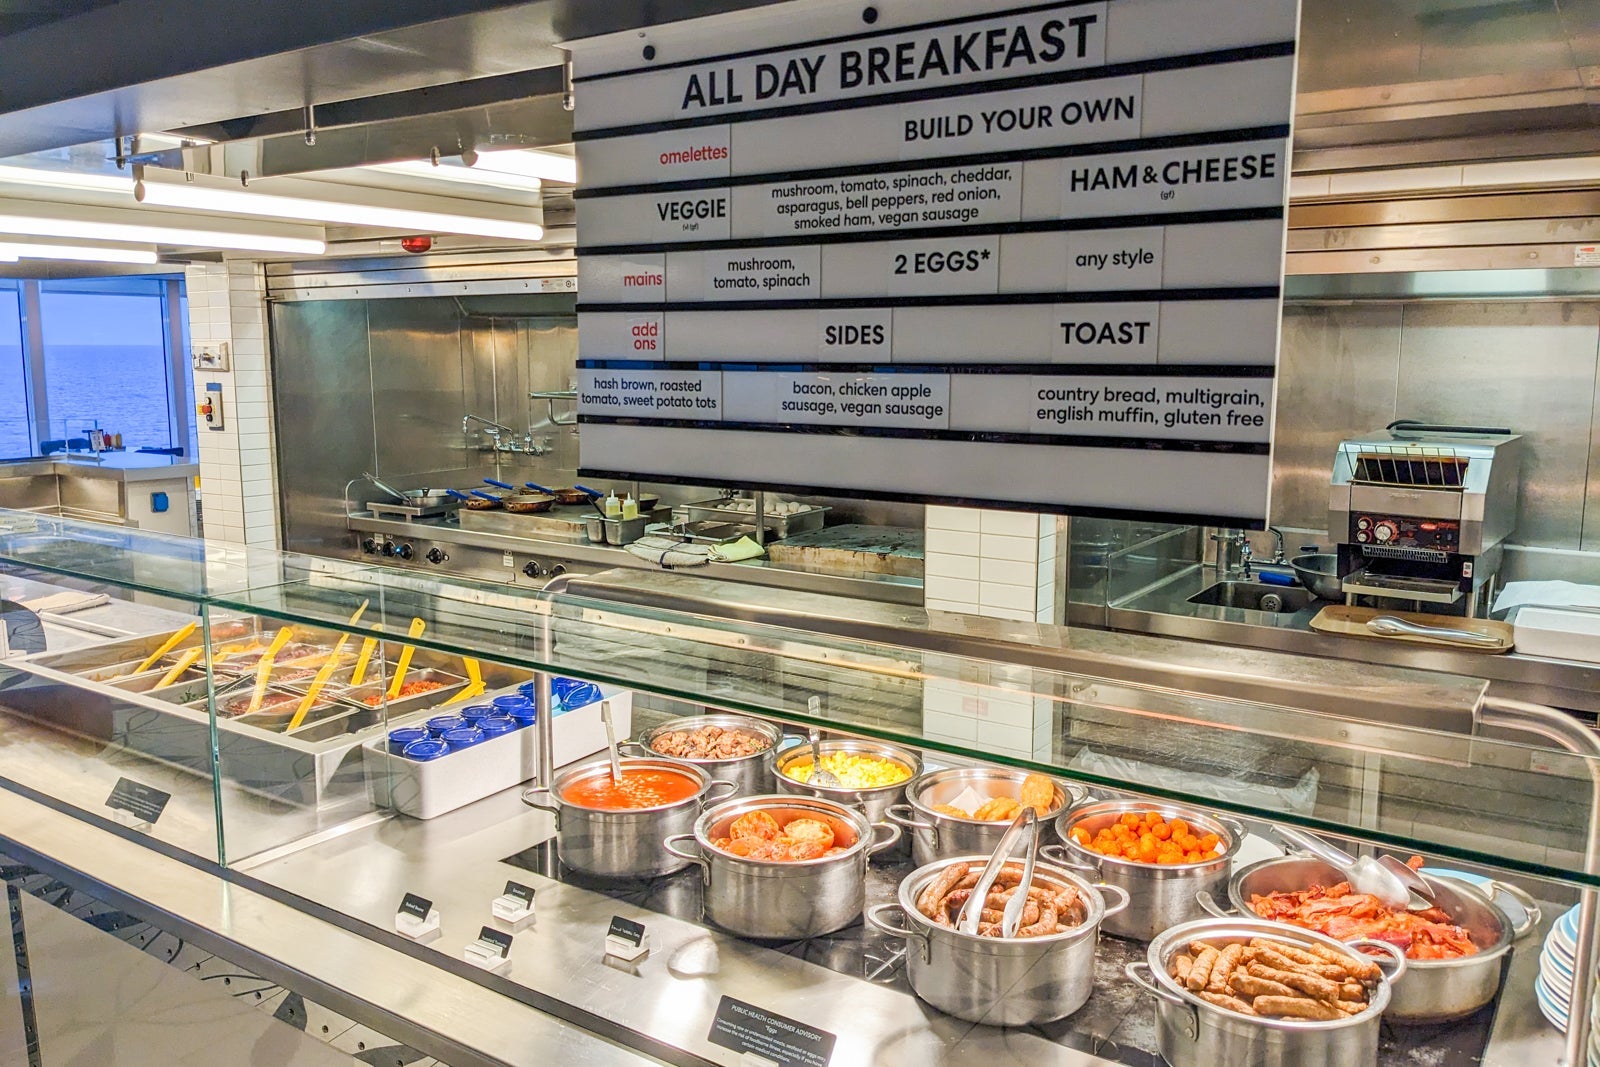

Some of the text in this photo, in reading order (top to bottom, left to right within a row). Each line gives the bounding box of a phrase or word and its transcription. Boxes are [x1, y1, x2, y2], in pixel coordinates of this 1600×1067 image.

[681, 14, 1098, 110] ALL DAY BREAKFAST
[905, 95, 1134, 142] BUILD YOUR OWN
[660, 146, 728, 165] omelettes
[772, 166, 1012, 198] mushroom, tomato, spinach, cheddar,
[777, 186, 1000, 217] asparagus, bell peppers, red onion,
[1160, 191, 1174, 200] (gf)
[657, 198, 726, 221] VEGGIE
[794, 208, 979, 229] smoked ham, vegan sausage
[728, 257, 795, 271] mushroom,
[894, 254, 908, 275] 2
[1075, 248, 1154, 270] any style
[624, 271, 662, 286] mains
[713, 273, 810, 291] tomato, spinach
[632, 322, 658, 337] add
[825, 324, 884, 345] SIDES
[1060, 321, 1150, 345] TOAST
[634, 339, 656, 350] ons
[594, 377, 702, 392] hash brown, roasted
[793, 381, 932, 401] bacon, chicken apple
[581, 391, 717, 410] tomato, sweet potato tots
[1038, 386, 1264, 409] country bread, multigrain,
[782, 401, 943, 420] sausage, vegan sausage
[1037, 405, 1264, 428] english muffin, gluten free
[731, 1005, 821, 1041] PUBLIC HEALTH CONSUMER ADVISORY
